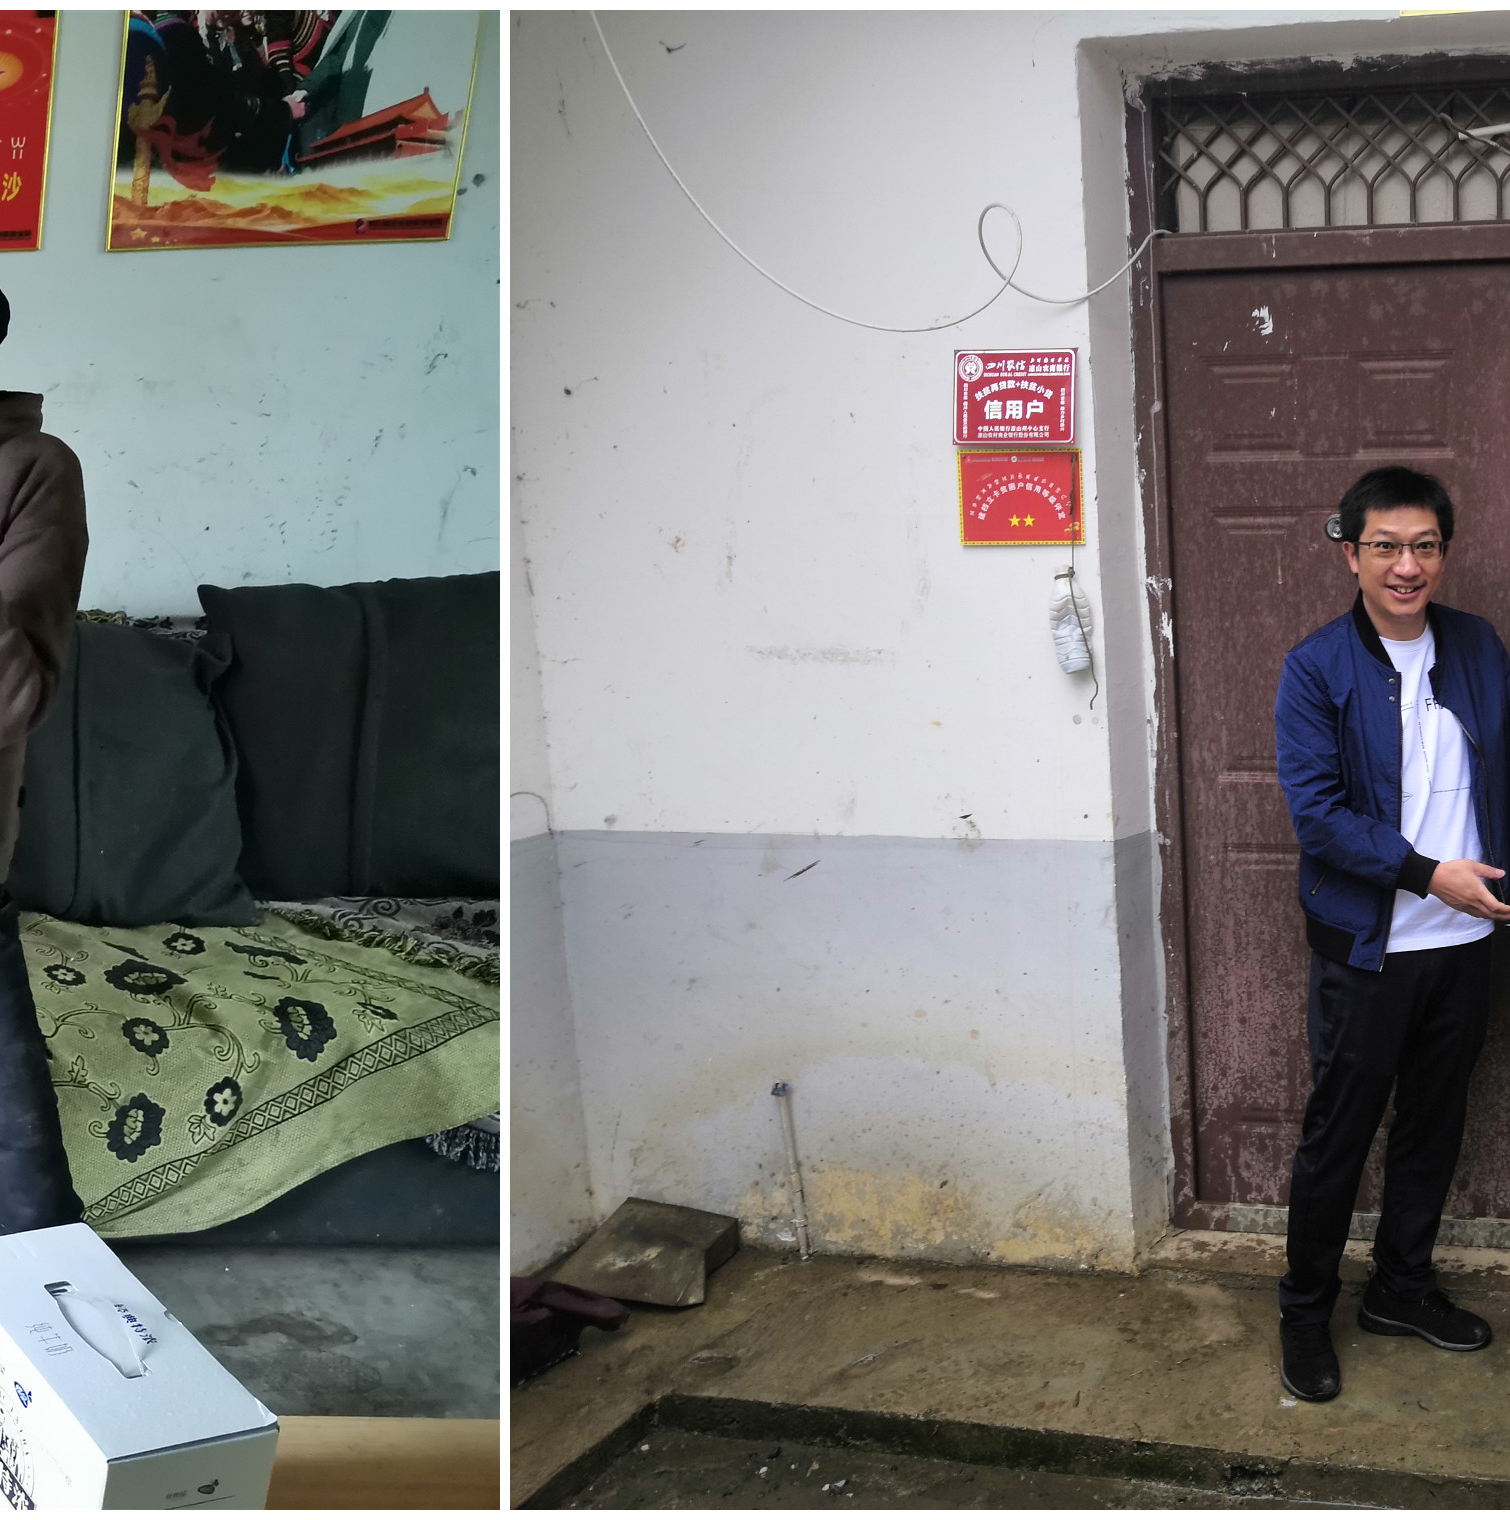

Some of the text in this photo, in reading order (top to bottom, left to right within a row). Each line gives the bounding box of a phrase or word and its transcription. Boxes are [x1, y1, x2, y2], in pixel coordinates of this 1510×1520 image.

[985, 359, 1026, 371] 四川农信
[983, 399, 1044, 420] 信用户
